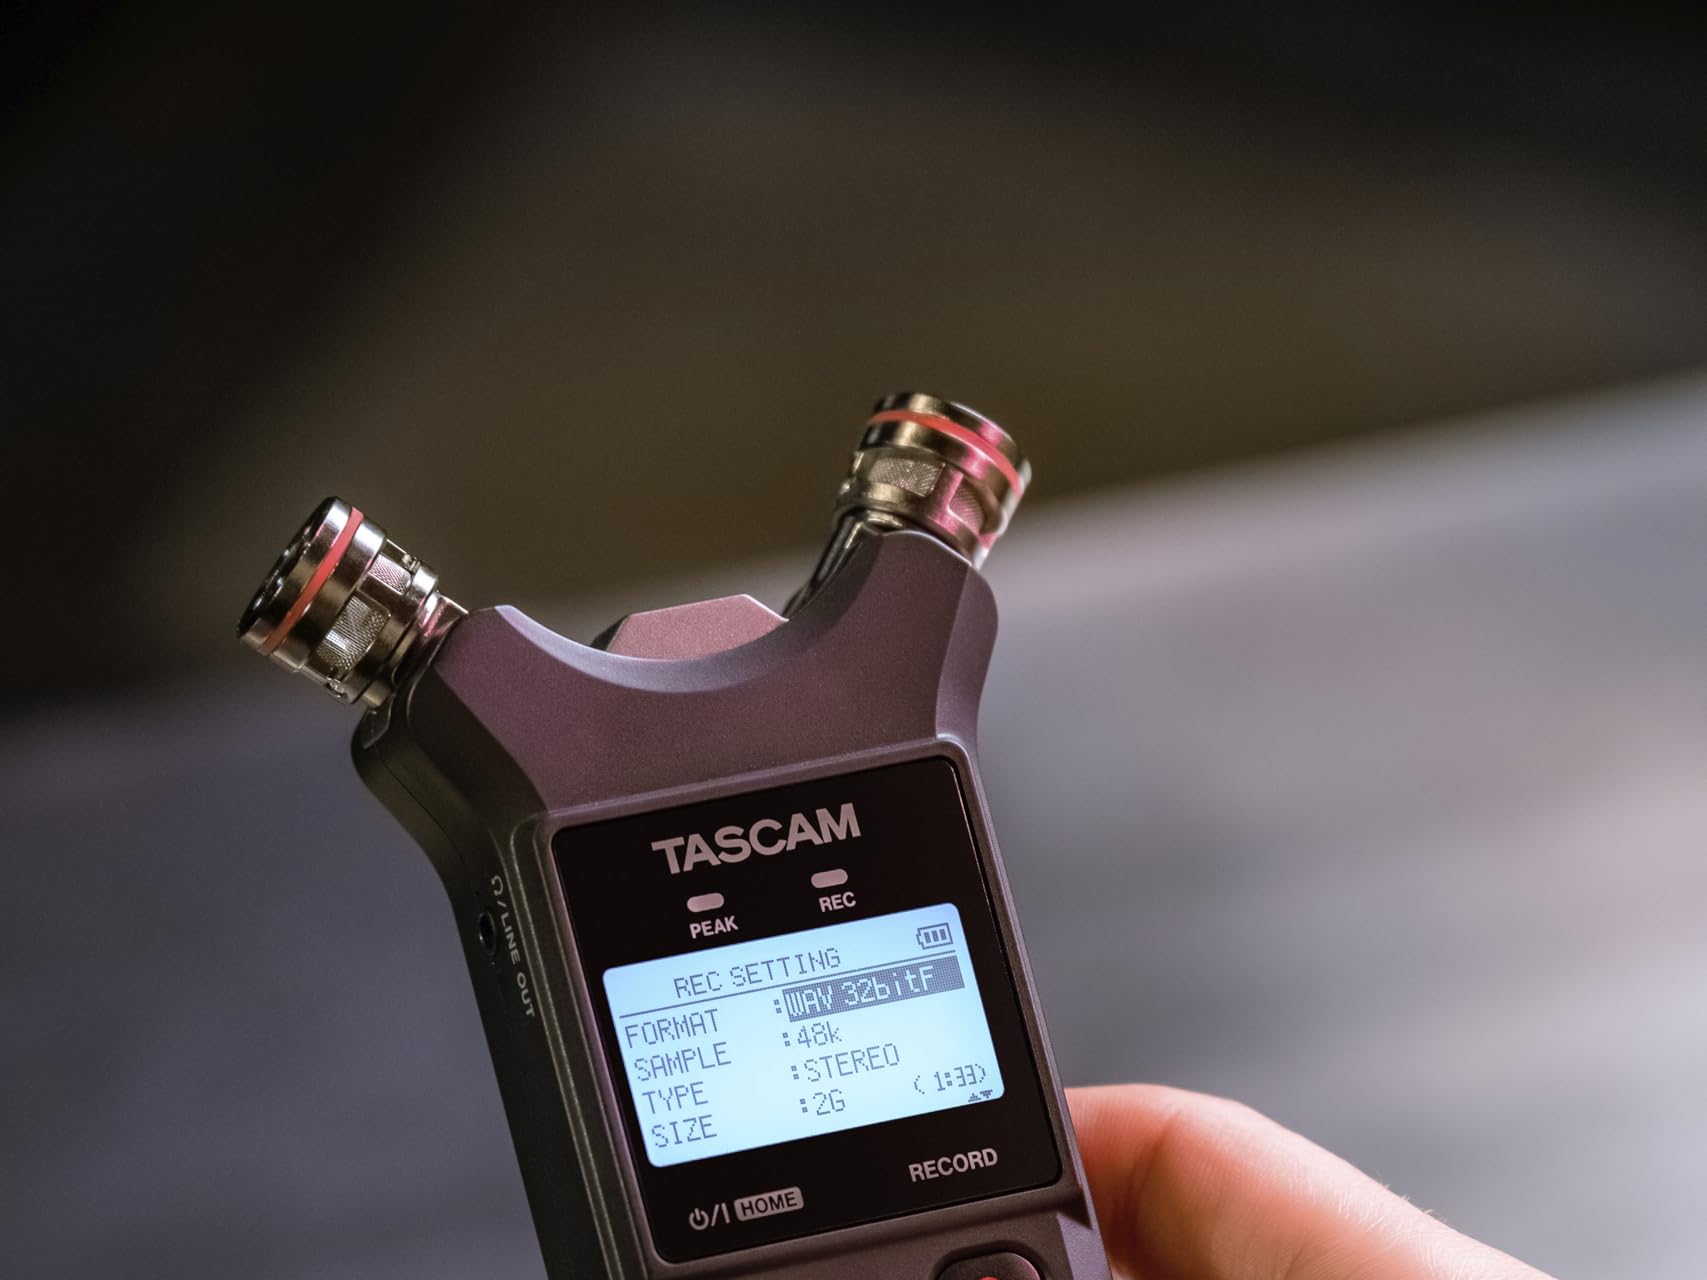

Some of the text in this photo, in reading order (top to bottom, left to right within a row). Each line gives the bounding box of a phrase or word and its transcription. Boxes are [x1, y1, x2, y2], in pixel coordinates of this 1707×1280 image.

[651, 802, 861, 875] TASCAM
[818, 890, 857, 912] REC
[688, 915, 738, 939] PEAK
[673, 947, 841, 998] REC SETTING
[516, 972, 535, 1017] OUT
[624, 1008, 719, 1048] FORMAT
[841, 964, 935, 1004] 32bitF
[634, 1041, 731, 1082] SAMPLE
[641, 1081, 709, 1115] TYPE
[651, 1114, 718, 1148] SIZE
[908, 1148, 998, 1182] RECORD
[740, 1191, 798, 1218] HOME
